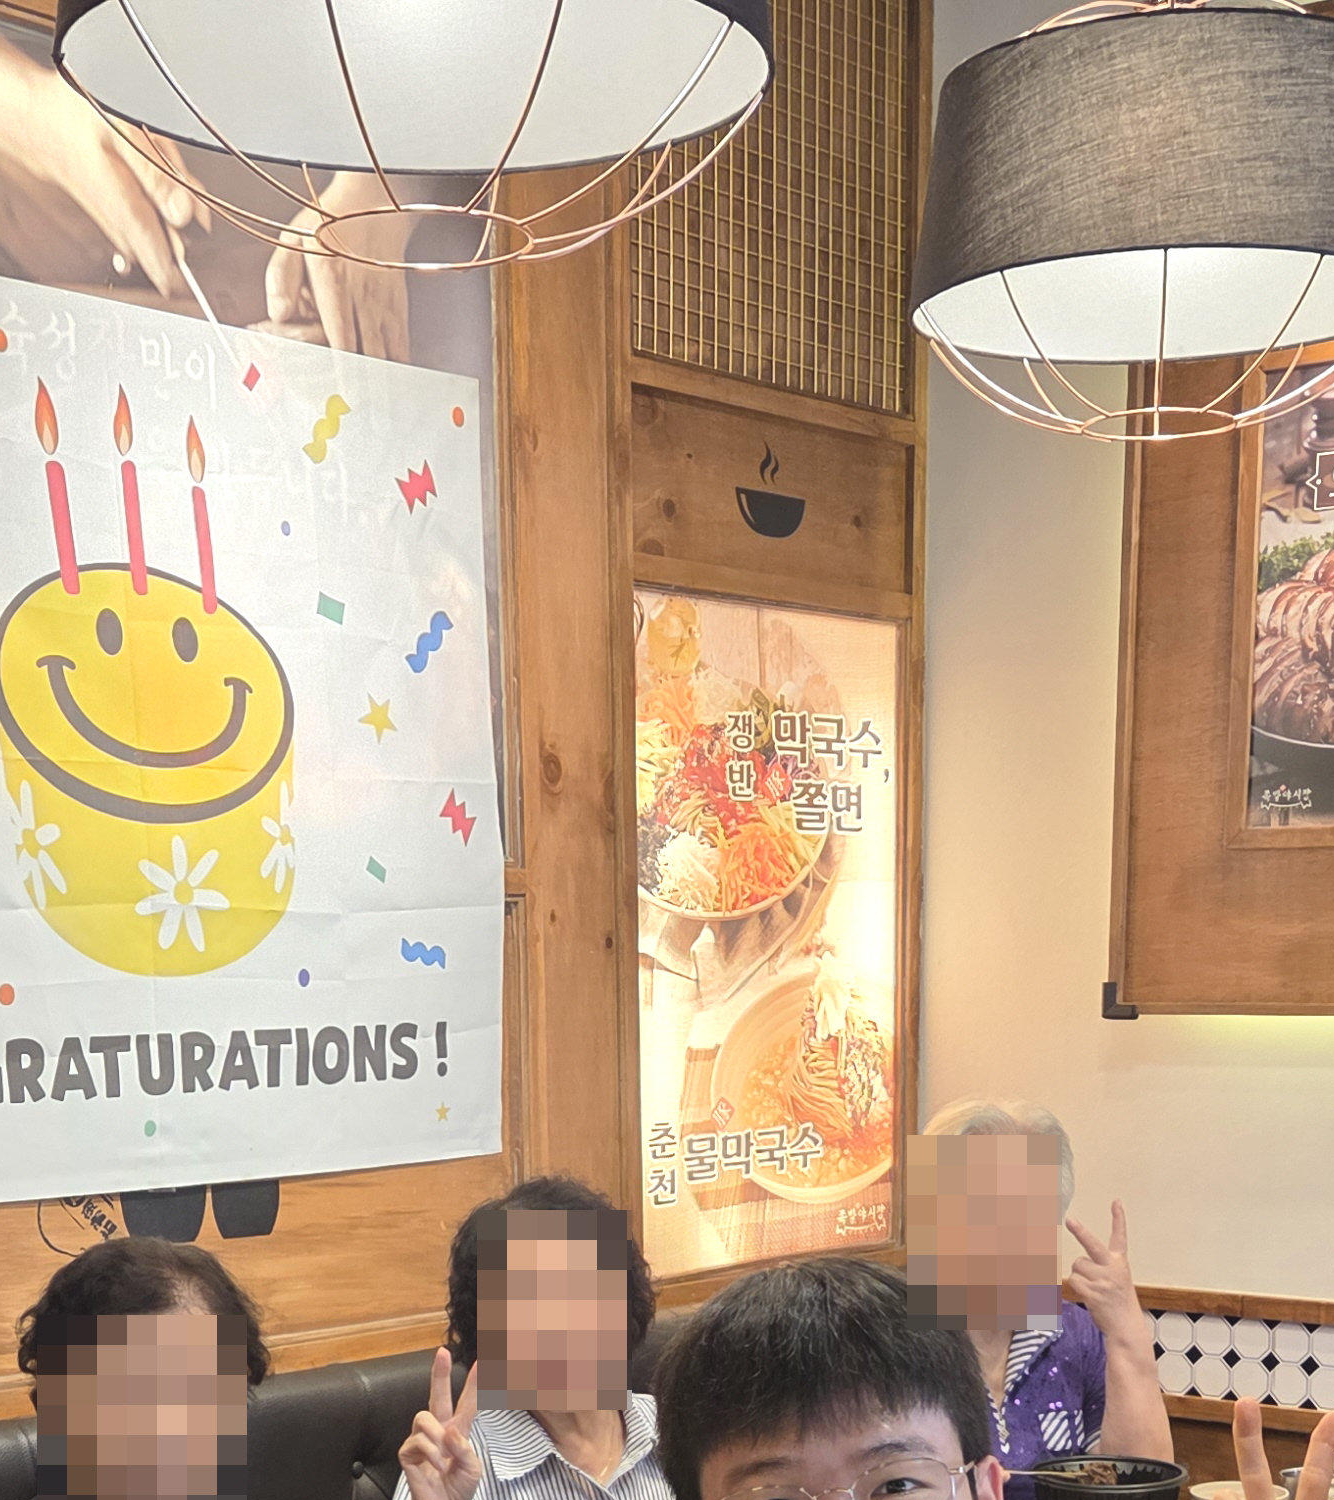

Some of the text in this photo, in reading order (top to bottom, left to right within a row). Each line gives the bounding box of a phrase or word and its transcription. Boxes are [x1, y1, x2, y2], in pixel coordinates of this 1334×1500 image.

[793, 781, 863, 832] 쫄면
[648, 1122, 677, 1206] 춘천
[684, 1125, 821, 1182] 물막국수
